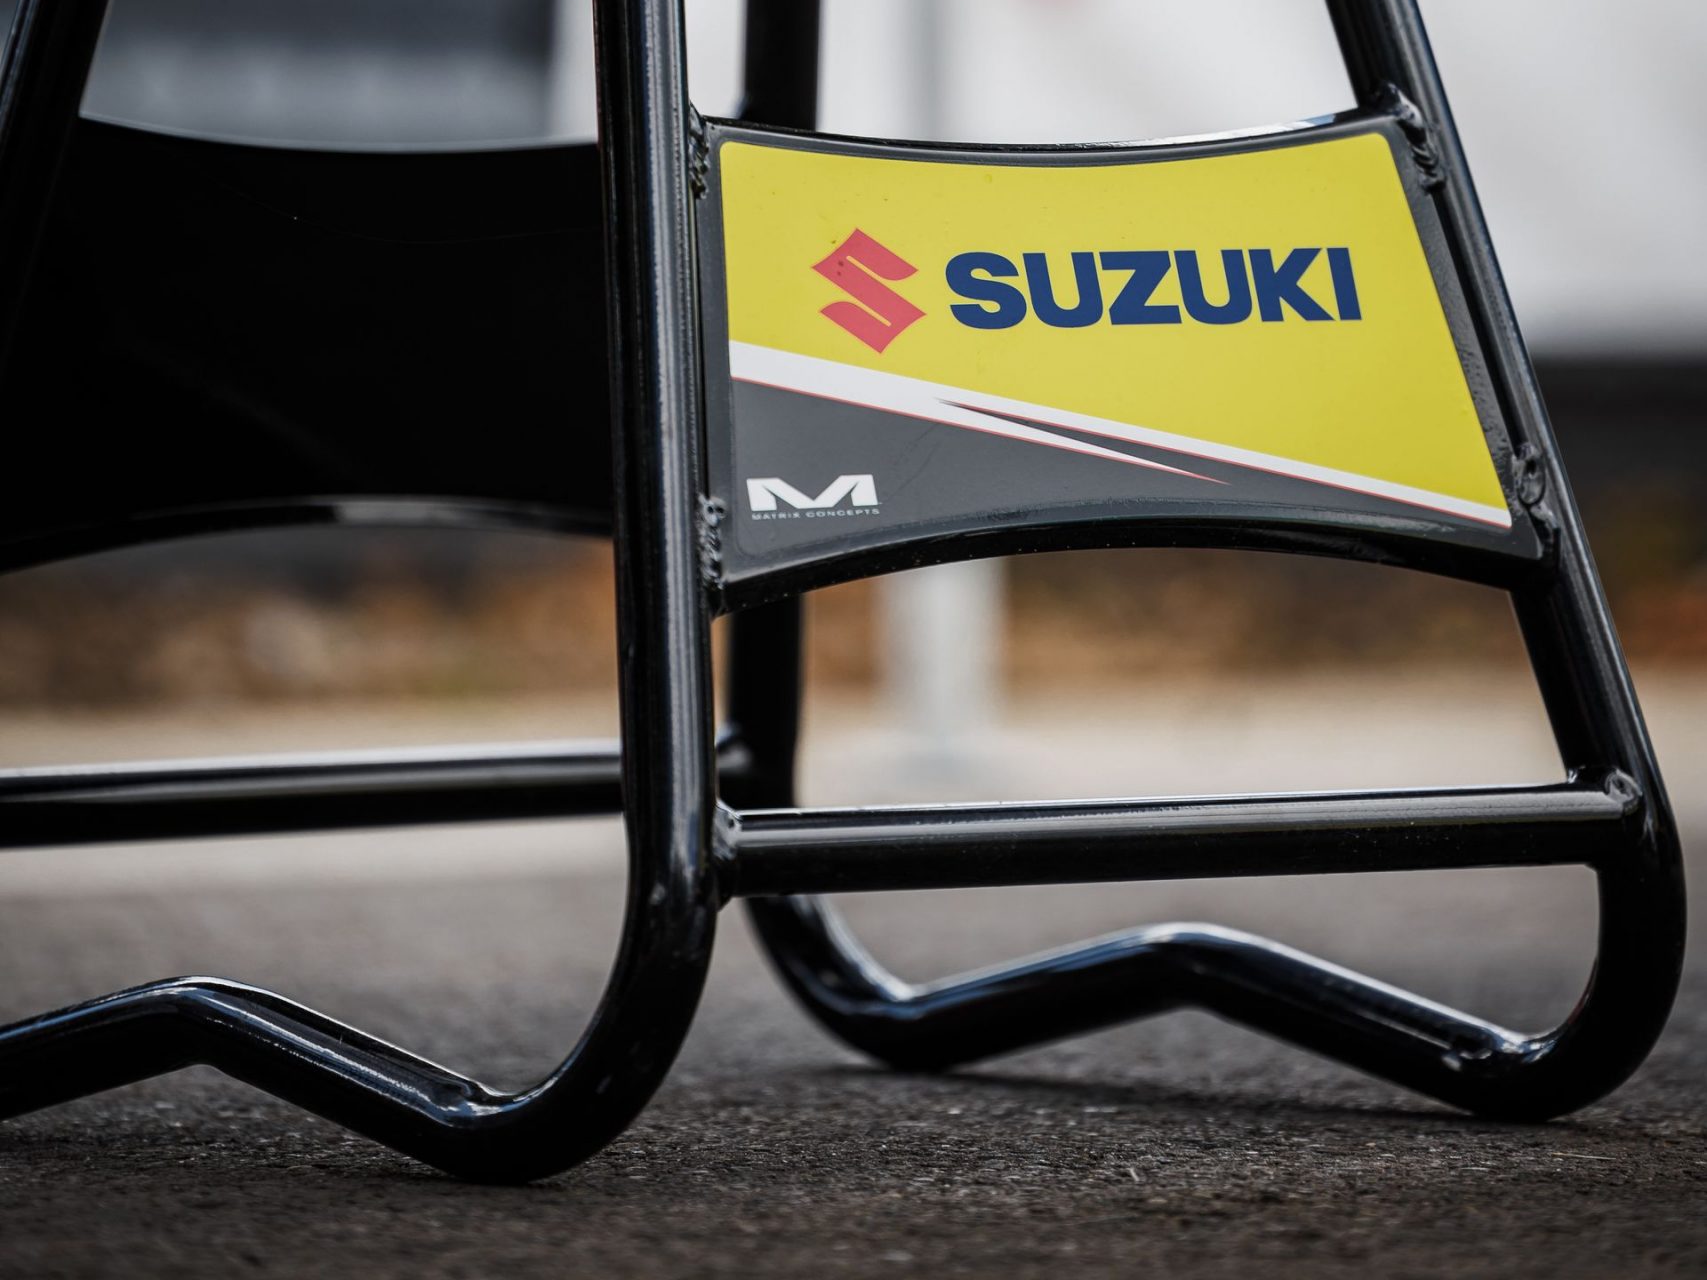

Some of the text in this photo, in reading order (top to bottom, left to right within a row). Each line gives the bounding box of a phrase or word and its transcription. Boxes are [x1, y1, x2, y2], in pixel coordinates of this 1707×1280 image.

[945, 247, 1362, 330] SUZUKI
[751, 508, 880, 521] MATRIX CONCEPTS
